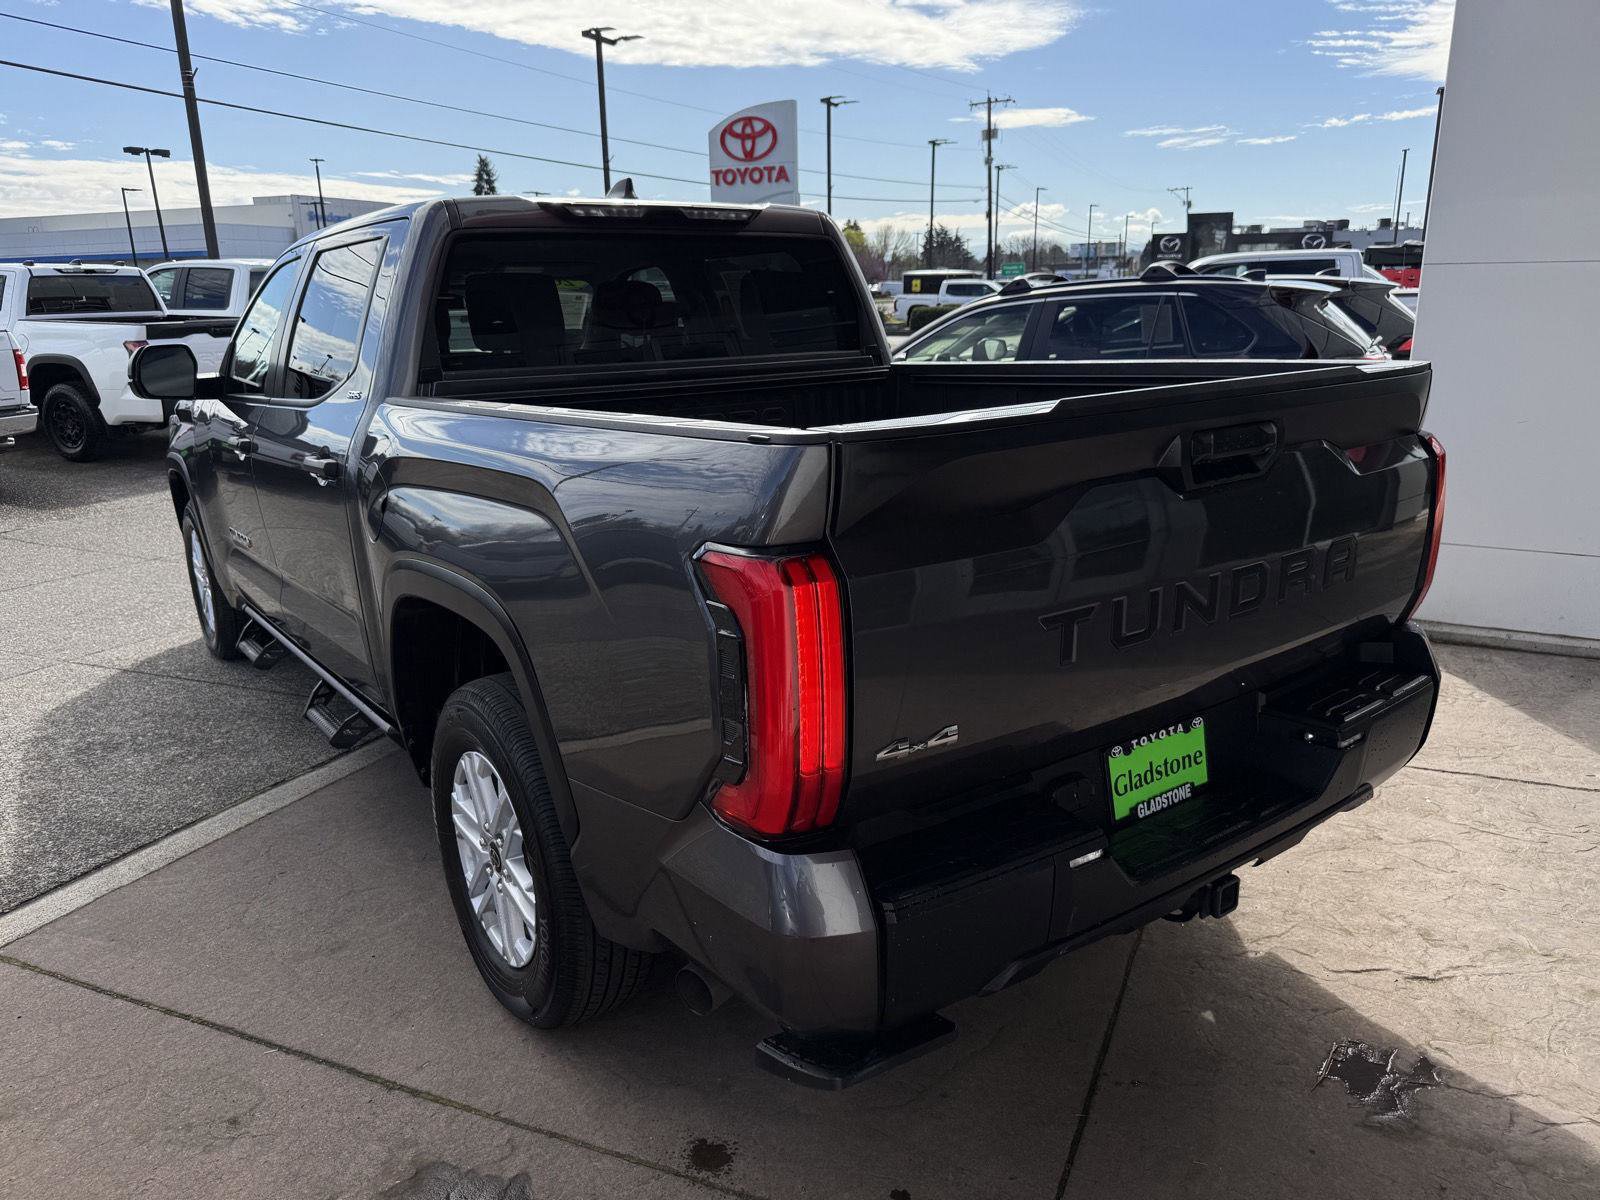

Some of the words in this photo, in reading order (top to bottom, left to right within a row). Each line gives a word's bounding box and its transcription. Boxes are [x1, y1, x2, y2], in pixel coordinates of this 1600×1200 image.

[711, 165, 790, 186] TOYOTA
[1038, 533, 1359, 667] TUNDRA
[1131, 723, 1184, 749] TOYOTA
[1113, 749, 1203, 797] Gladstone
[1137, 783, 1192, 818] GLADSTONE
